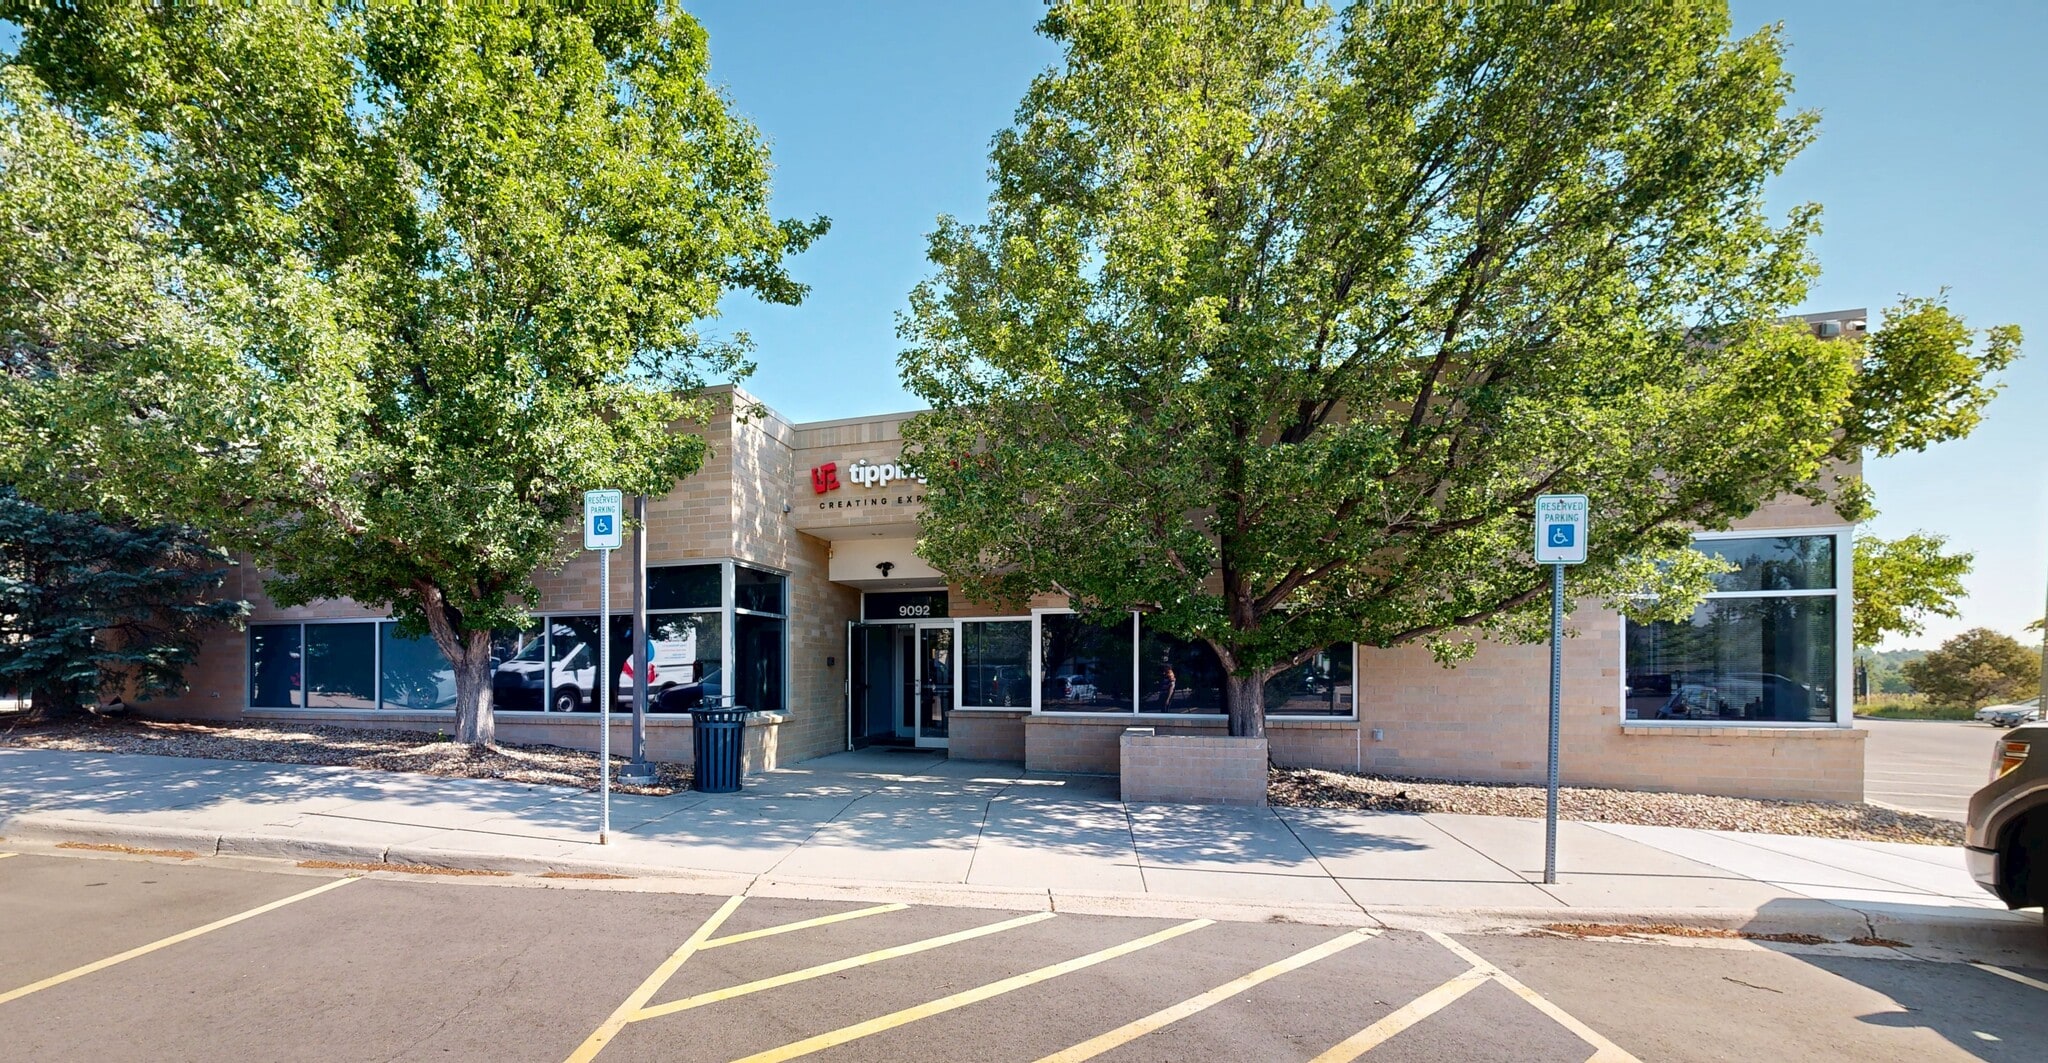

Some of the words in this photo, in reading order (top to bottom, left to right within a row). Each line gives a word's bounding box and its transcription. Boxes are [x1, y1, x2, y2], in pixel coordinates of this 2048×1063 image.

[588, 496, 618, 504] RESERVED
[819, 497, 888, 510] CREATING
[897, 495, 922, 504] EXP
[591, 505, 615, 513] PARKING
[1541, 502, 1583, 511] RESERVED
[1545, 513, 1579, 522] PARKING
[899, 605, 930, 616] 9092
